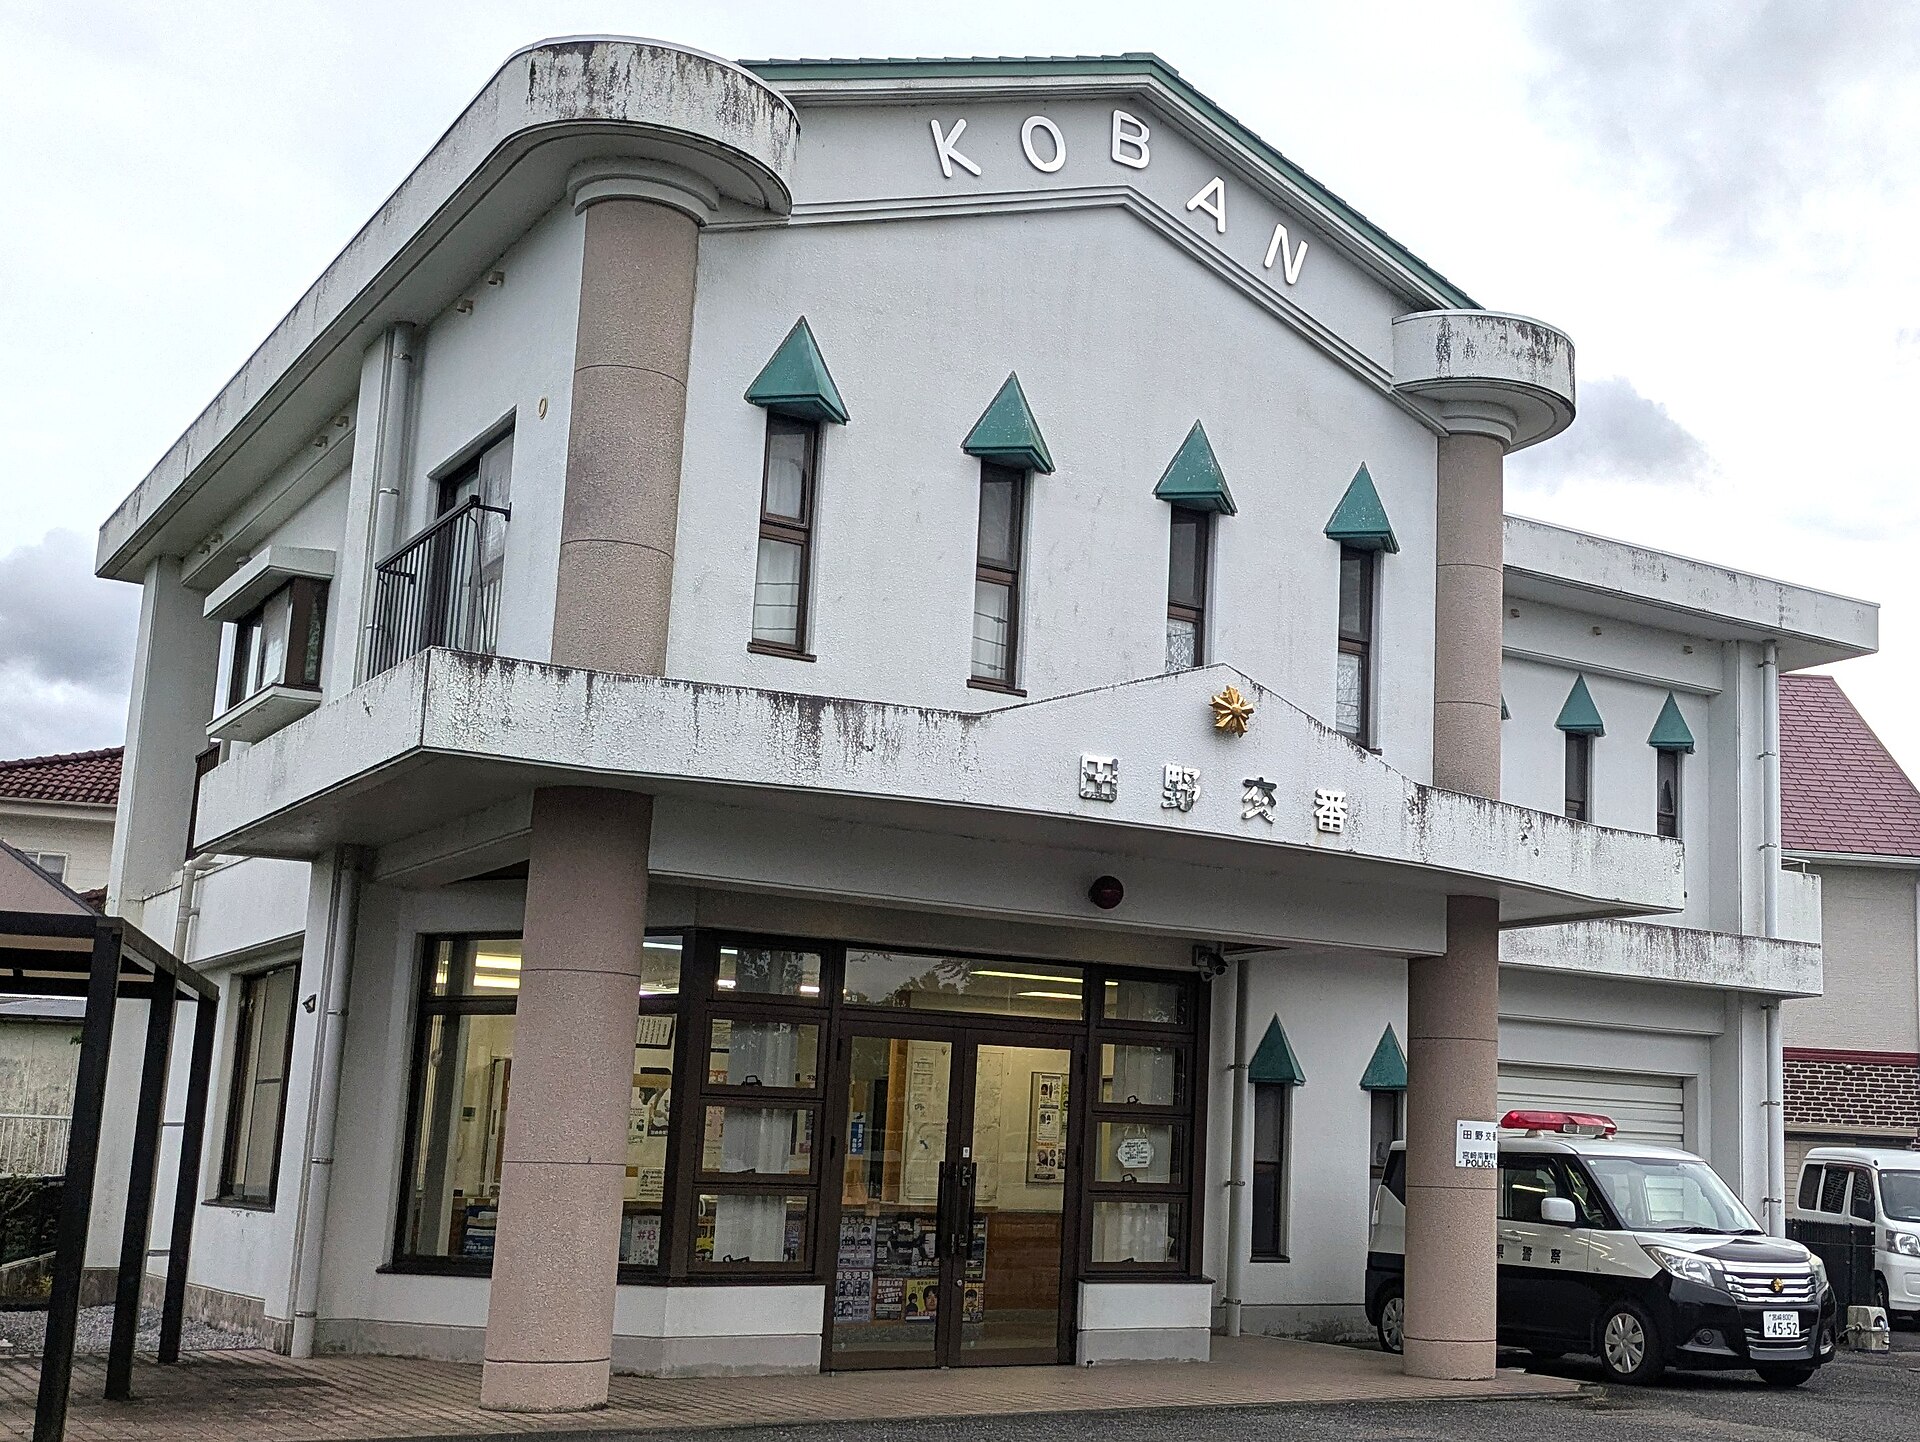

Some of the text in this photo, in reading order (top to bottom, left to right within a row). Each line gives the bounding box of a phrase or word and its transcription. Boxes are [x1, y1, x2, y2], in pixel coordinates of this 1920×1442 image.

[930, 109, 1308, 285] KOBAN
[1079, 753, 1348, 833] 田野交番
[1772, 1322, 1798, 1336] 45-52
